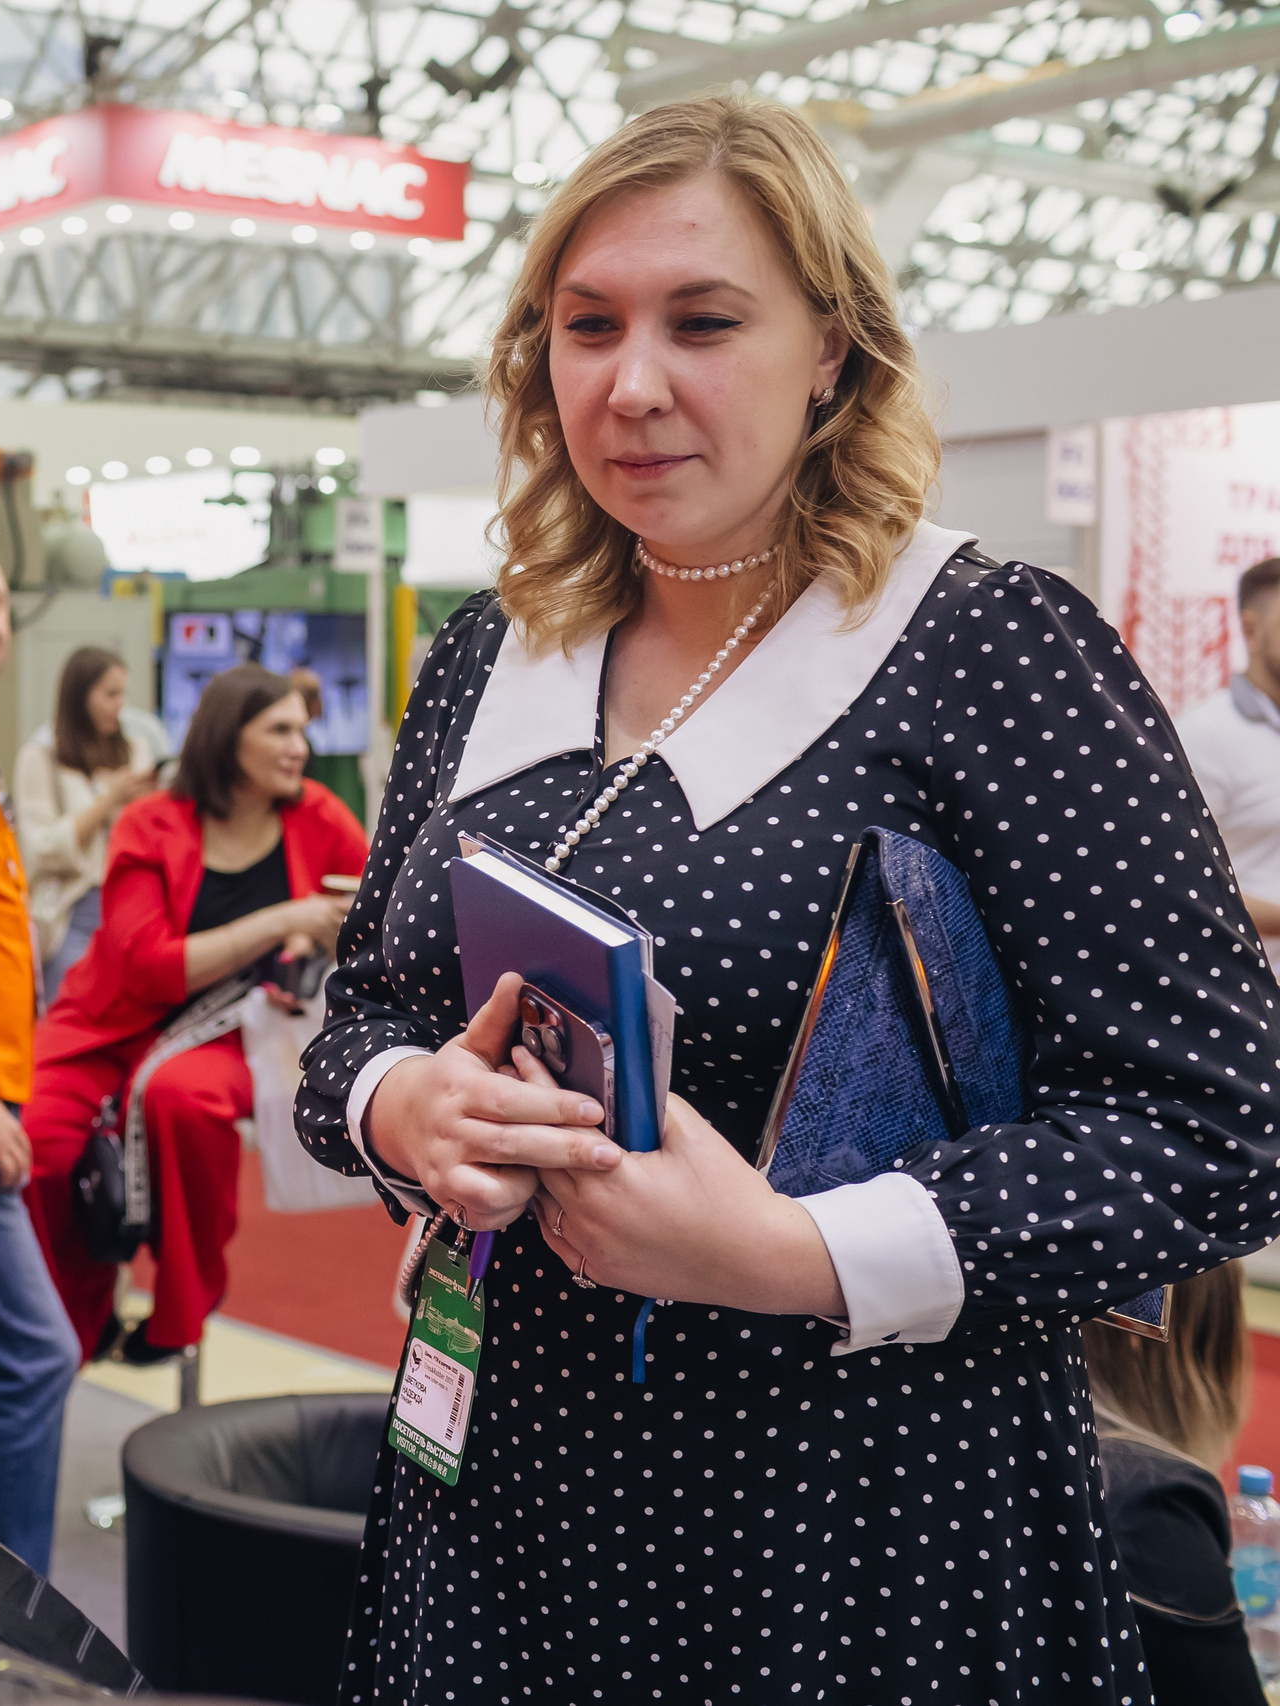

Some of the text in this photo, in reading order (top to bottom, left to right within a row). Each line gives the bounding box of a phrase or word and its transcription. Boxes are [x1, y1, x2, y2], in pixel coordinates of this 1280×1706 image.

[392, 1418, 459, 1469] ПОСЕТИТЕЛЬ ВЫСТАВКИ
[396, 1433, 417, 1456] VISITOR
